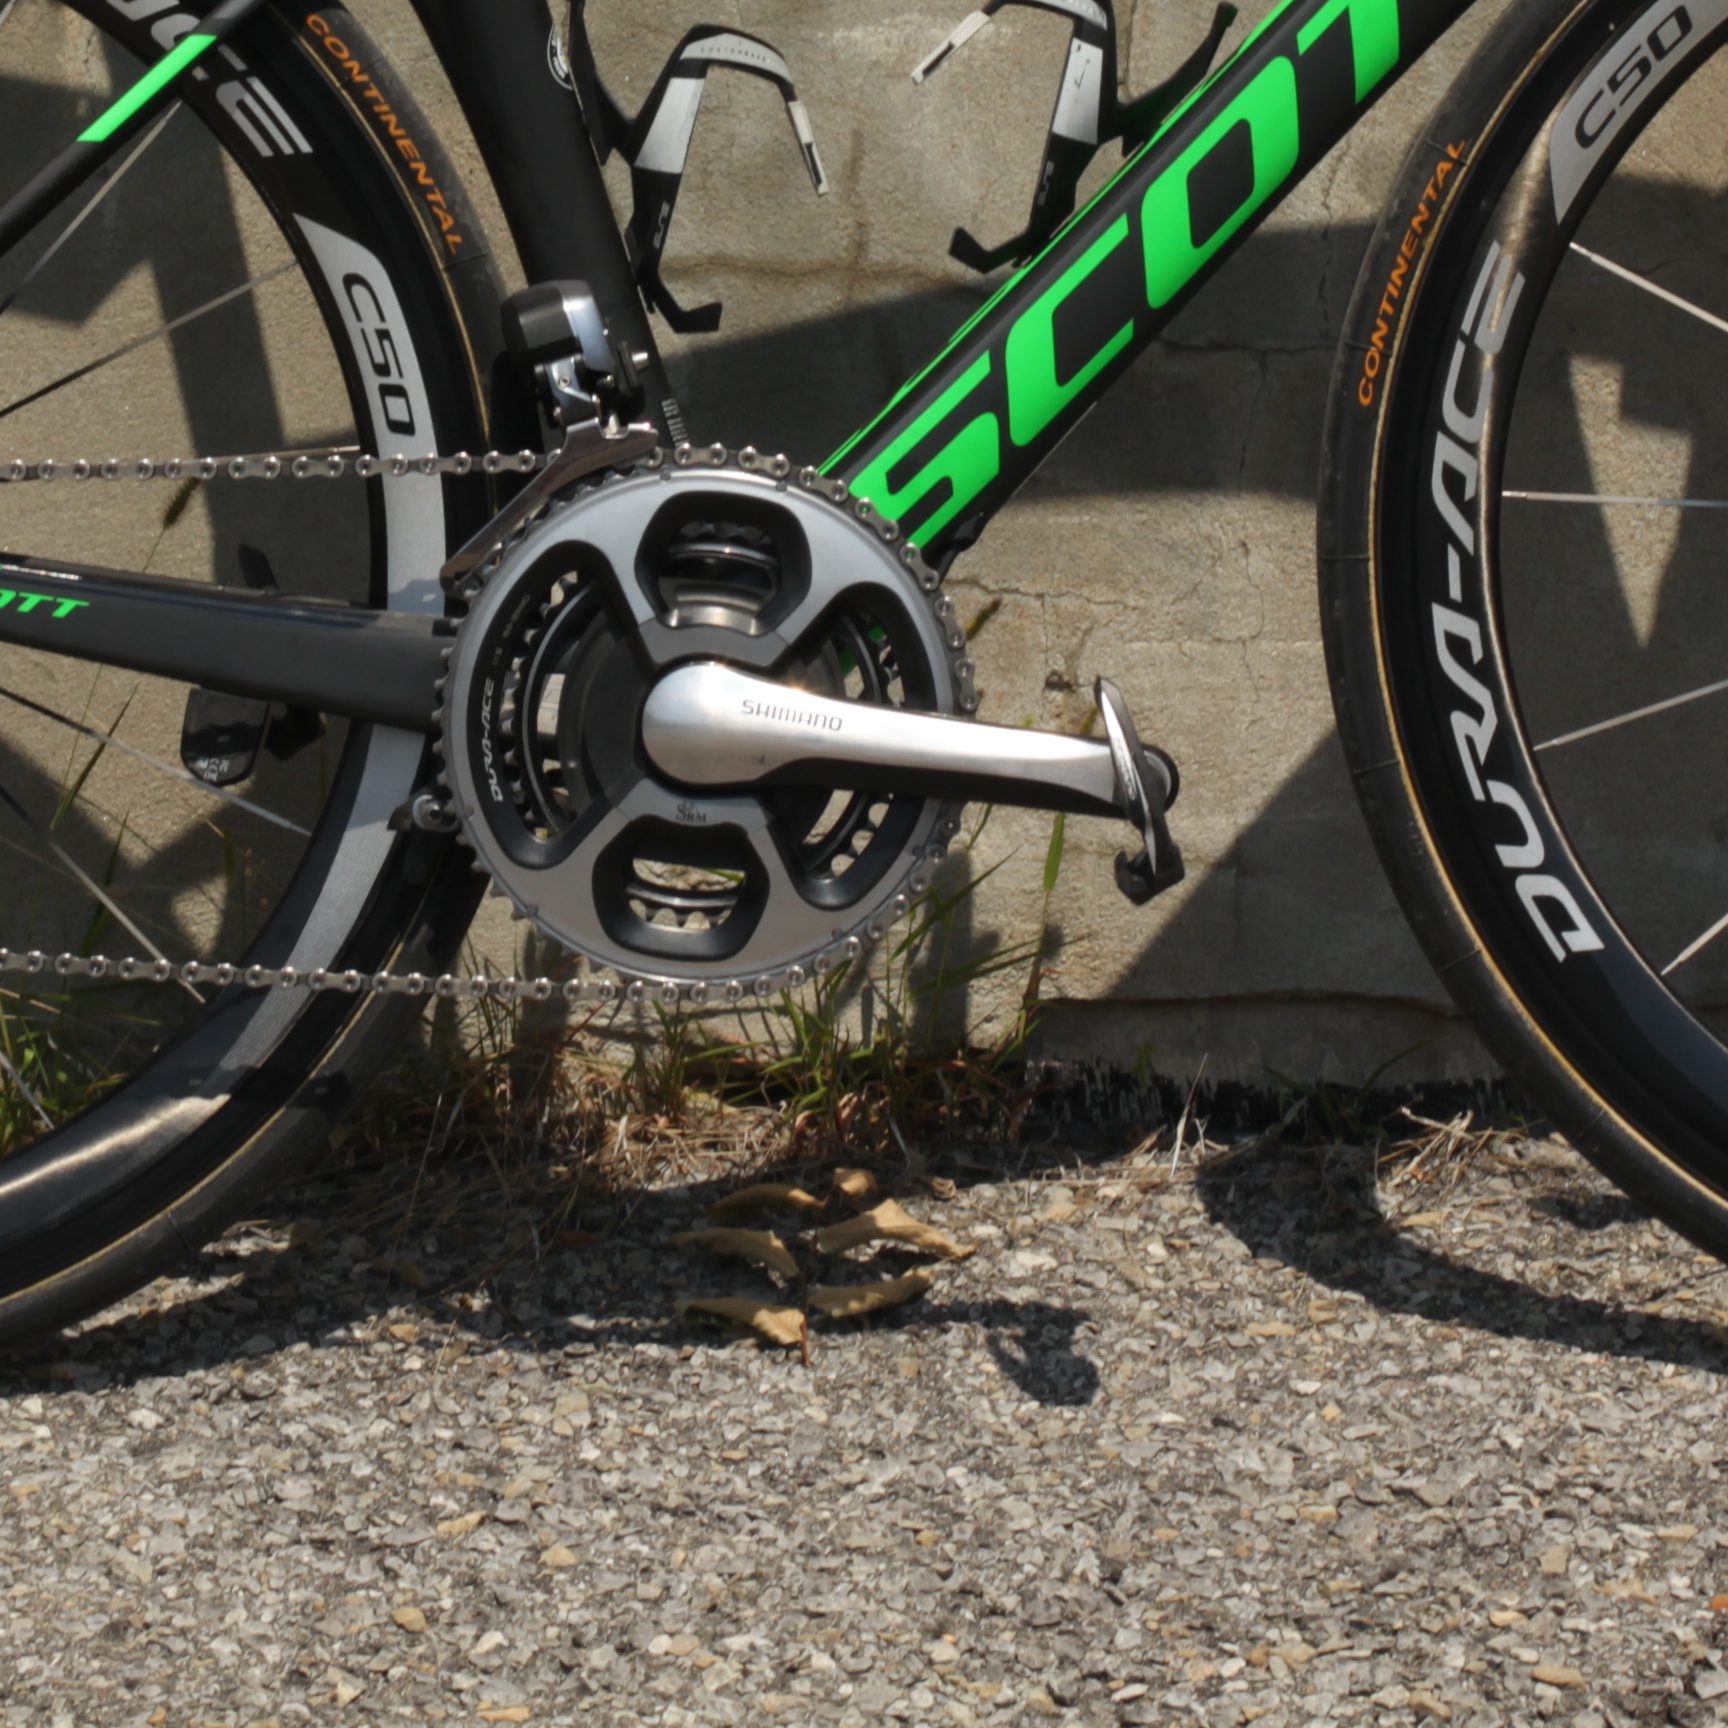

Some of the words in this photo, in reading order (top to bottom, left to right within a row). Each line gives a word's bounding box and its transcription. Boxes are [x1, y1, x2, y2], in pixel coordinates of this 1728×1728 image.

[306, 14, 465, 255] CONTINENTAL
[1575, 4, 1693, 149] C50
[342, 273, 416, 437] C50
[1358, 139, 1467, 407] CONTINENTAL
[1431, 240, 1605, 963] DURA-ACE
[741, 699, 844, 732] SHIMANO
